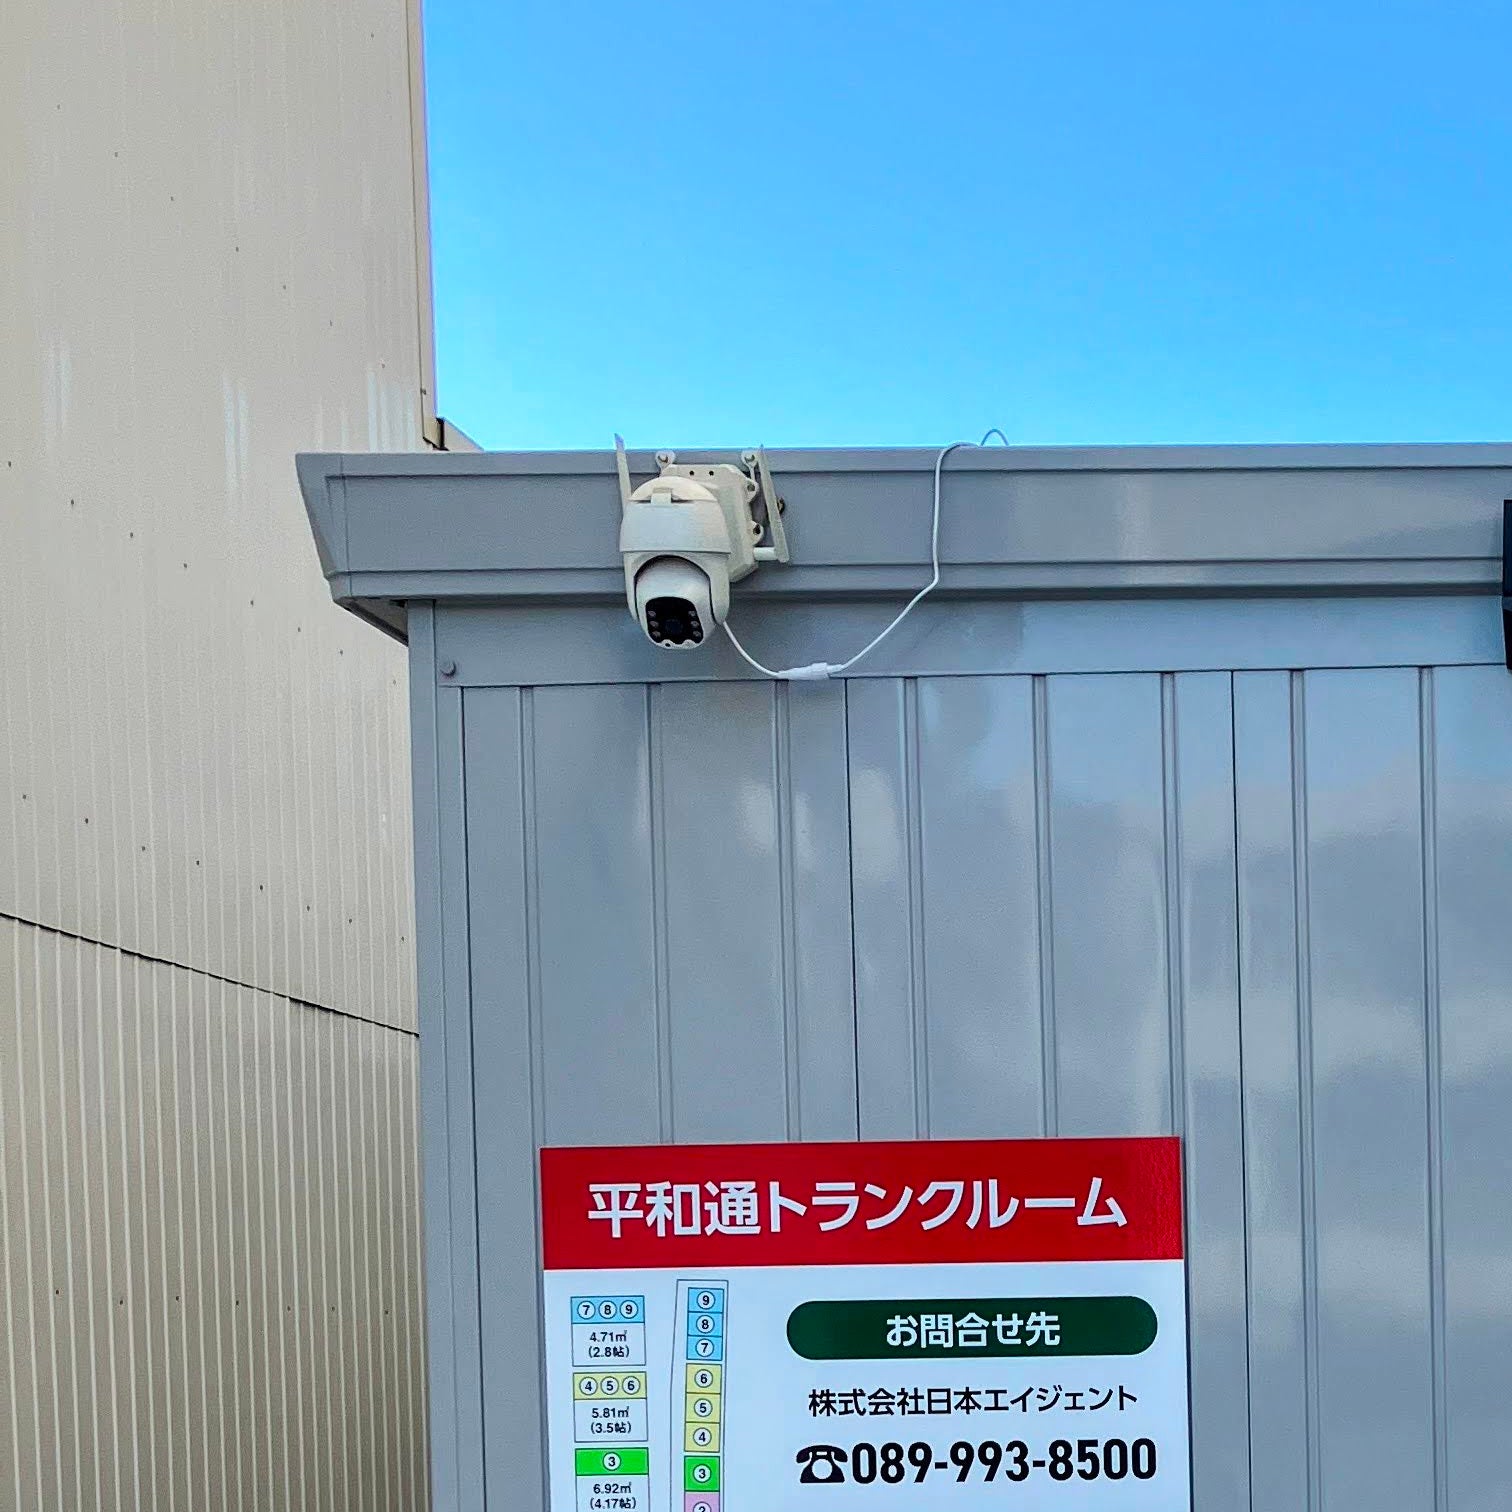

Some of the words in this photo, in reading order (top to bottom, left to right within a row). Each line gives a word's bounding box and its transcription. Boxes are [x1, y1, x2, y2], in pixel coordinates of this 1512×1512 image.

[588, 1176, 1128, 1238] 平和通トランクルーム
[886, 1311, 1061, 1348] お問合せ先
[808, 1384, 1138, 1417] 株式会社日本エイジェント
[851, 1437, 1157, 1484] 089-993-8500
